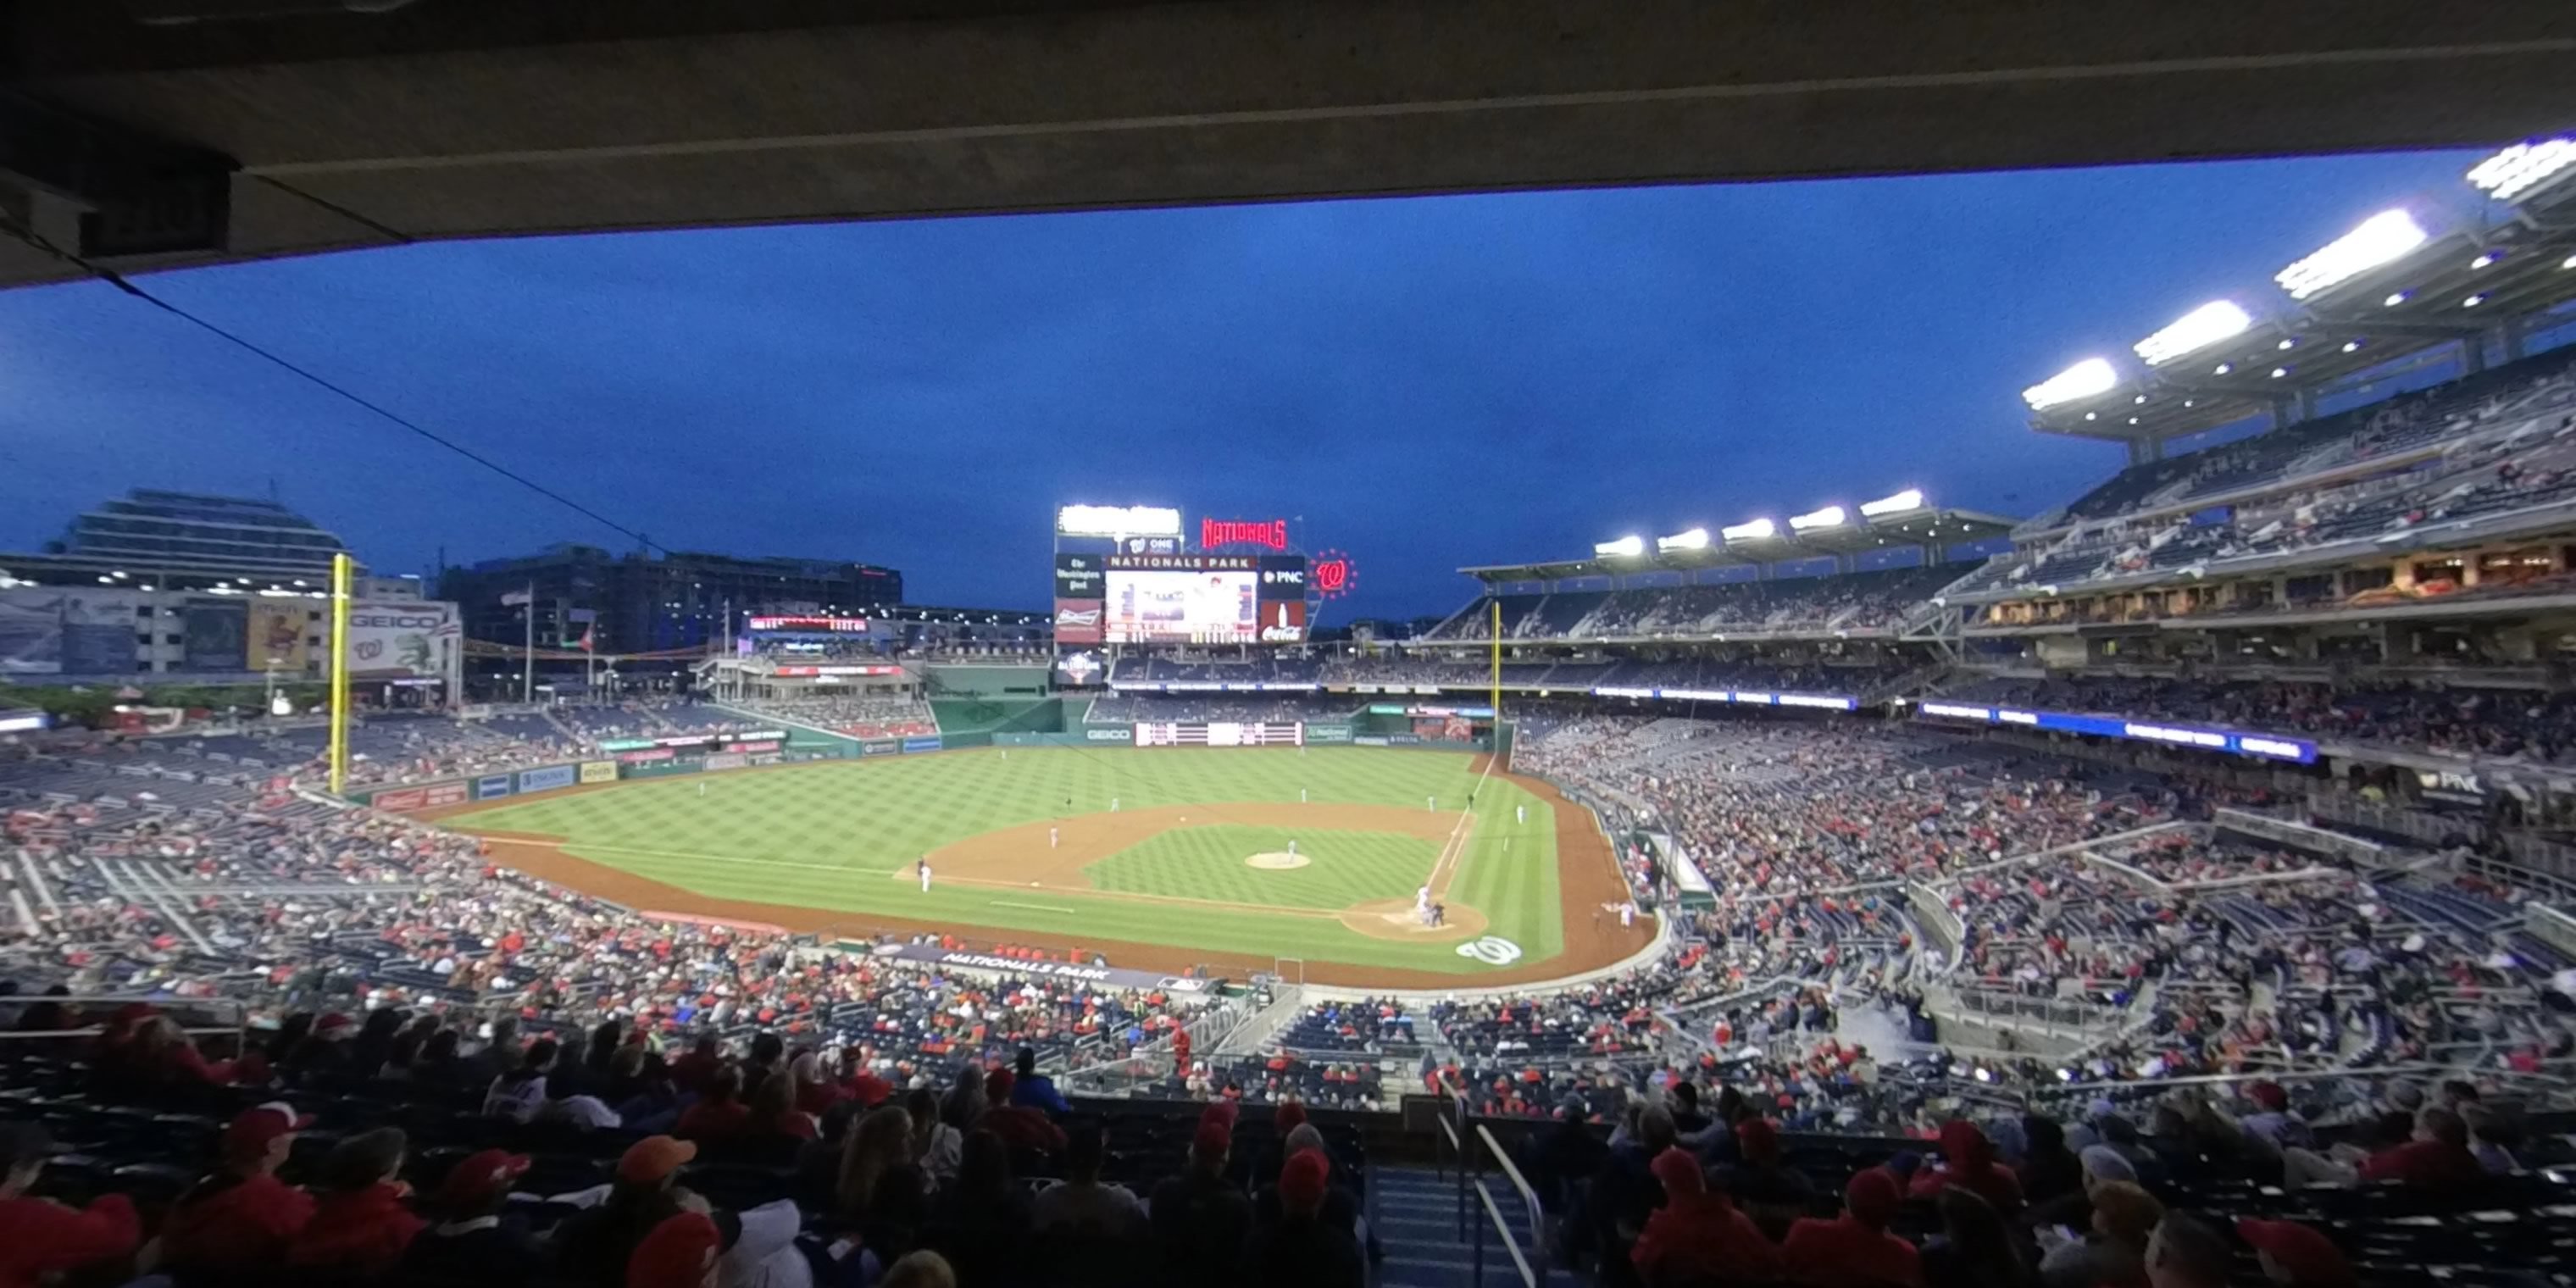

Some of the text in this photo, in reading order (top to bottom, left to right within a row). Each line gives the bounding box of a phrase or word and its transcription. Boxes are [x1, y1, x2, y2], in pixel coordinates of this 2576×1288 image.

[1202, 519, 1286, 550] NATIONALS
[1111, 557, 1249, 569] NATIONALS PARK
[1276, 571, 1303, 583] PNC
[349, 614, 438, 629] GEICO
[1087, 730, 1130, 740] GEICO
[943, 952, 1110, 980] NATIONALS PARK
